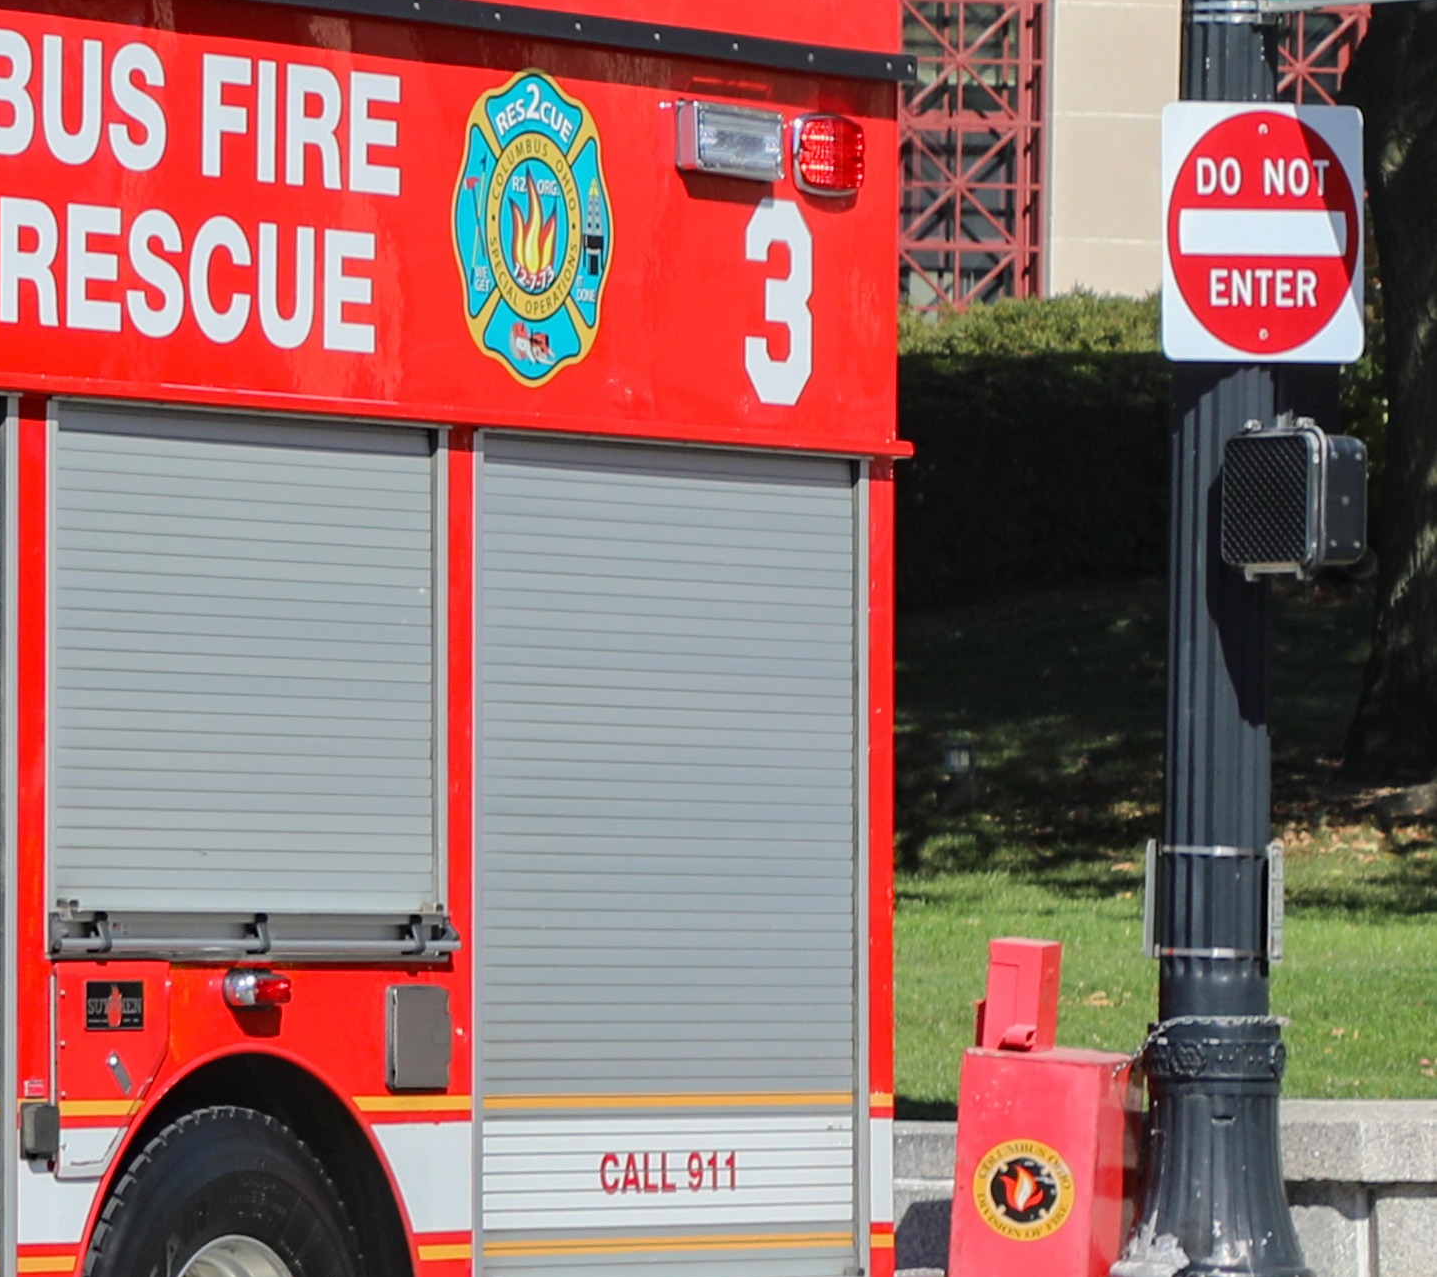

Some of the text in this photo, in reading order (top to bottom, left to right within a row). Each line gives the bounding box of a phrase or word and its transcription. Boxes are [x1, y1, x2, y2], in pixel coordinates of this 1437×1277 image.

[201, 53, 402, 197] FIRE
[492, 139, 577, 211] COLUMBUS OHIO
[1196, 157, 1330, 198] DO NOT
[489, 236, 578, 315] SPECIAL OPERATIONS
[744, 197, 814, 407] 3
[1210, 268, 1318, 307] ENTER
[600, 1150, 737, 1195] CALL 911
